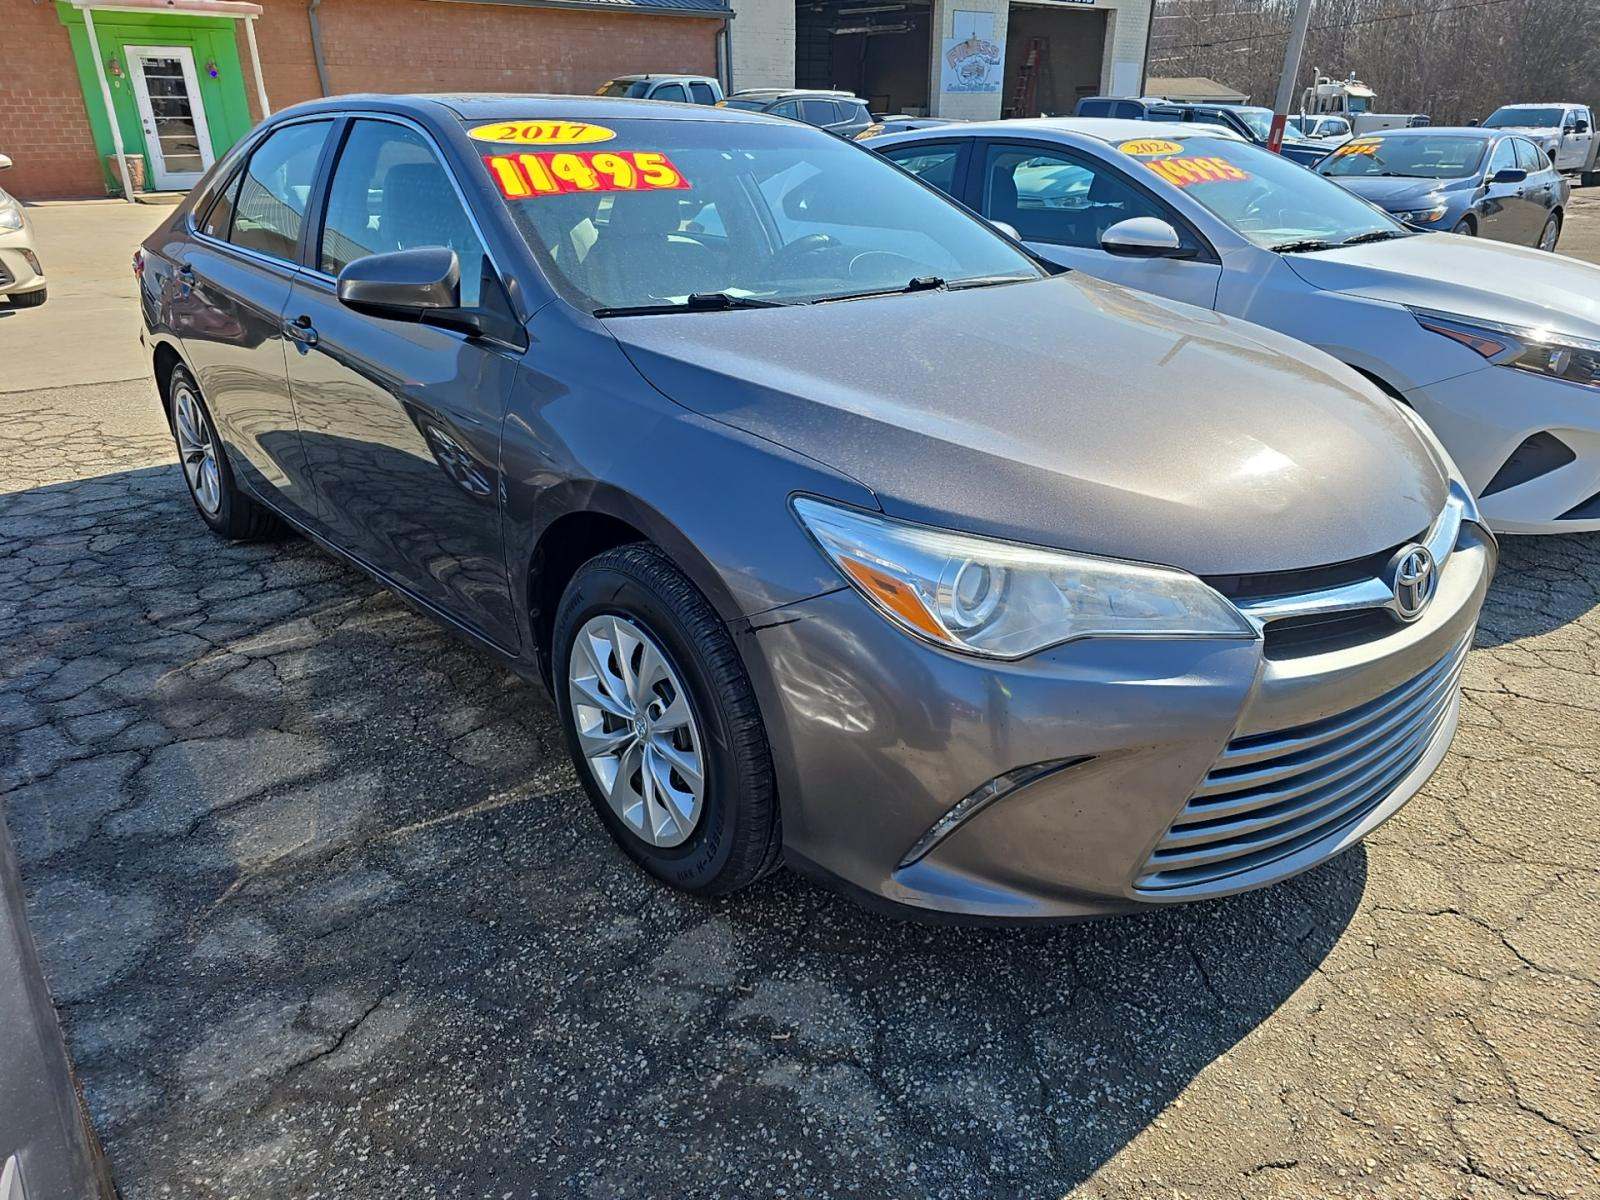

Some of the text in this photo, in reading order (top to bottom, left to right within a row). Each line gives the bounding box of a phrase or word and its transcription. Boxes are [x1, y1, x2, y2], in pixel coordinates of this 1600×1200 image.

[498, 125, 588, 141] 2017
[1130, 142, 1173, 154] 2024
[491, 152, 680, 196] 11495
[1145, 157, 1248, 187] 14995
